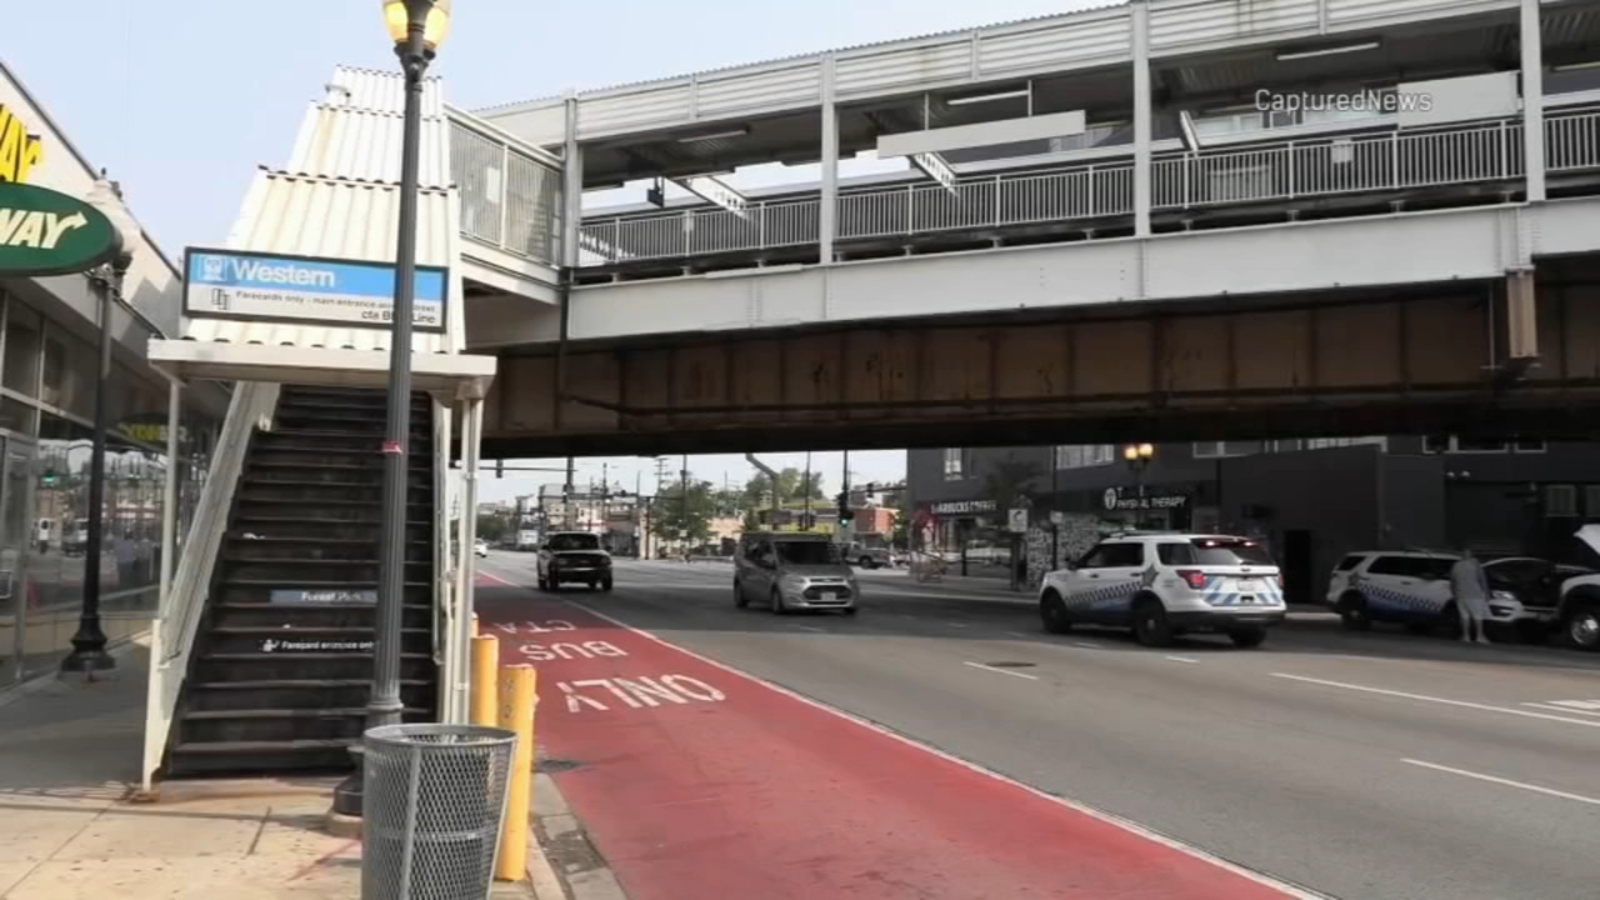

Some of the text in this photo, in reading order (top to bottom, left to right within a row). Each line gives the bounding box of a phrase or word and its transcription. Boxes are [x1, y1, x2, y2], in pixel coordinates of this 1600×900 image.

[231, 259, 334, 288] Western
[361, 310, 380, 320] cta
[493, 620, 578, 633] CTA
[358, 640, 374, 651] onl
[519, 641, 629, 660] BUS
[556, 674, 726, 713] ONLY
